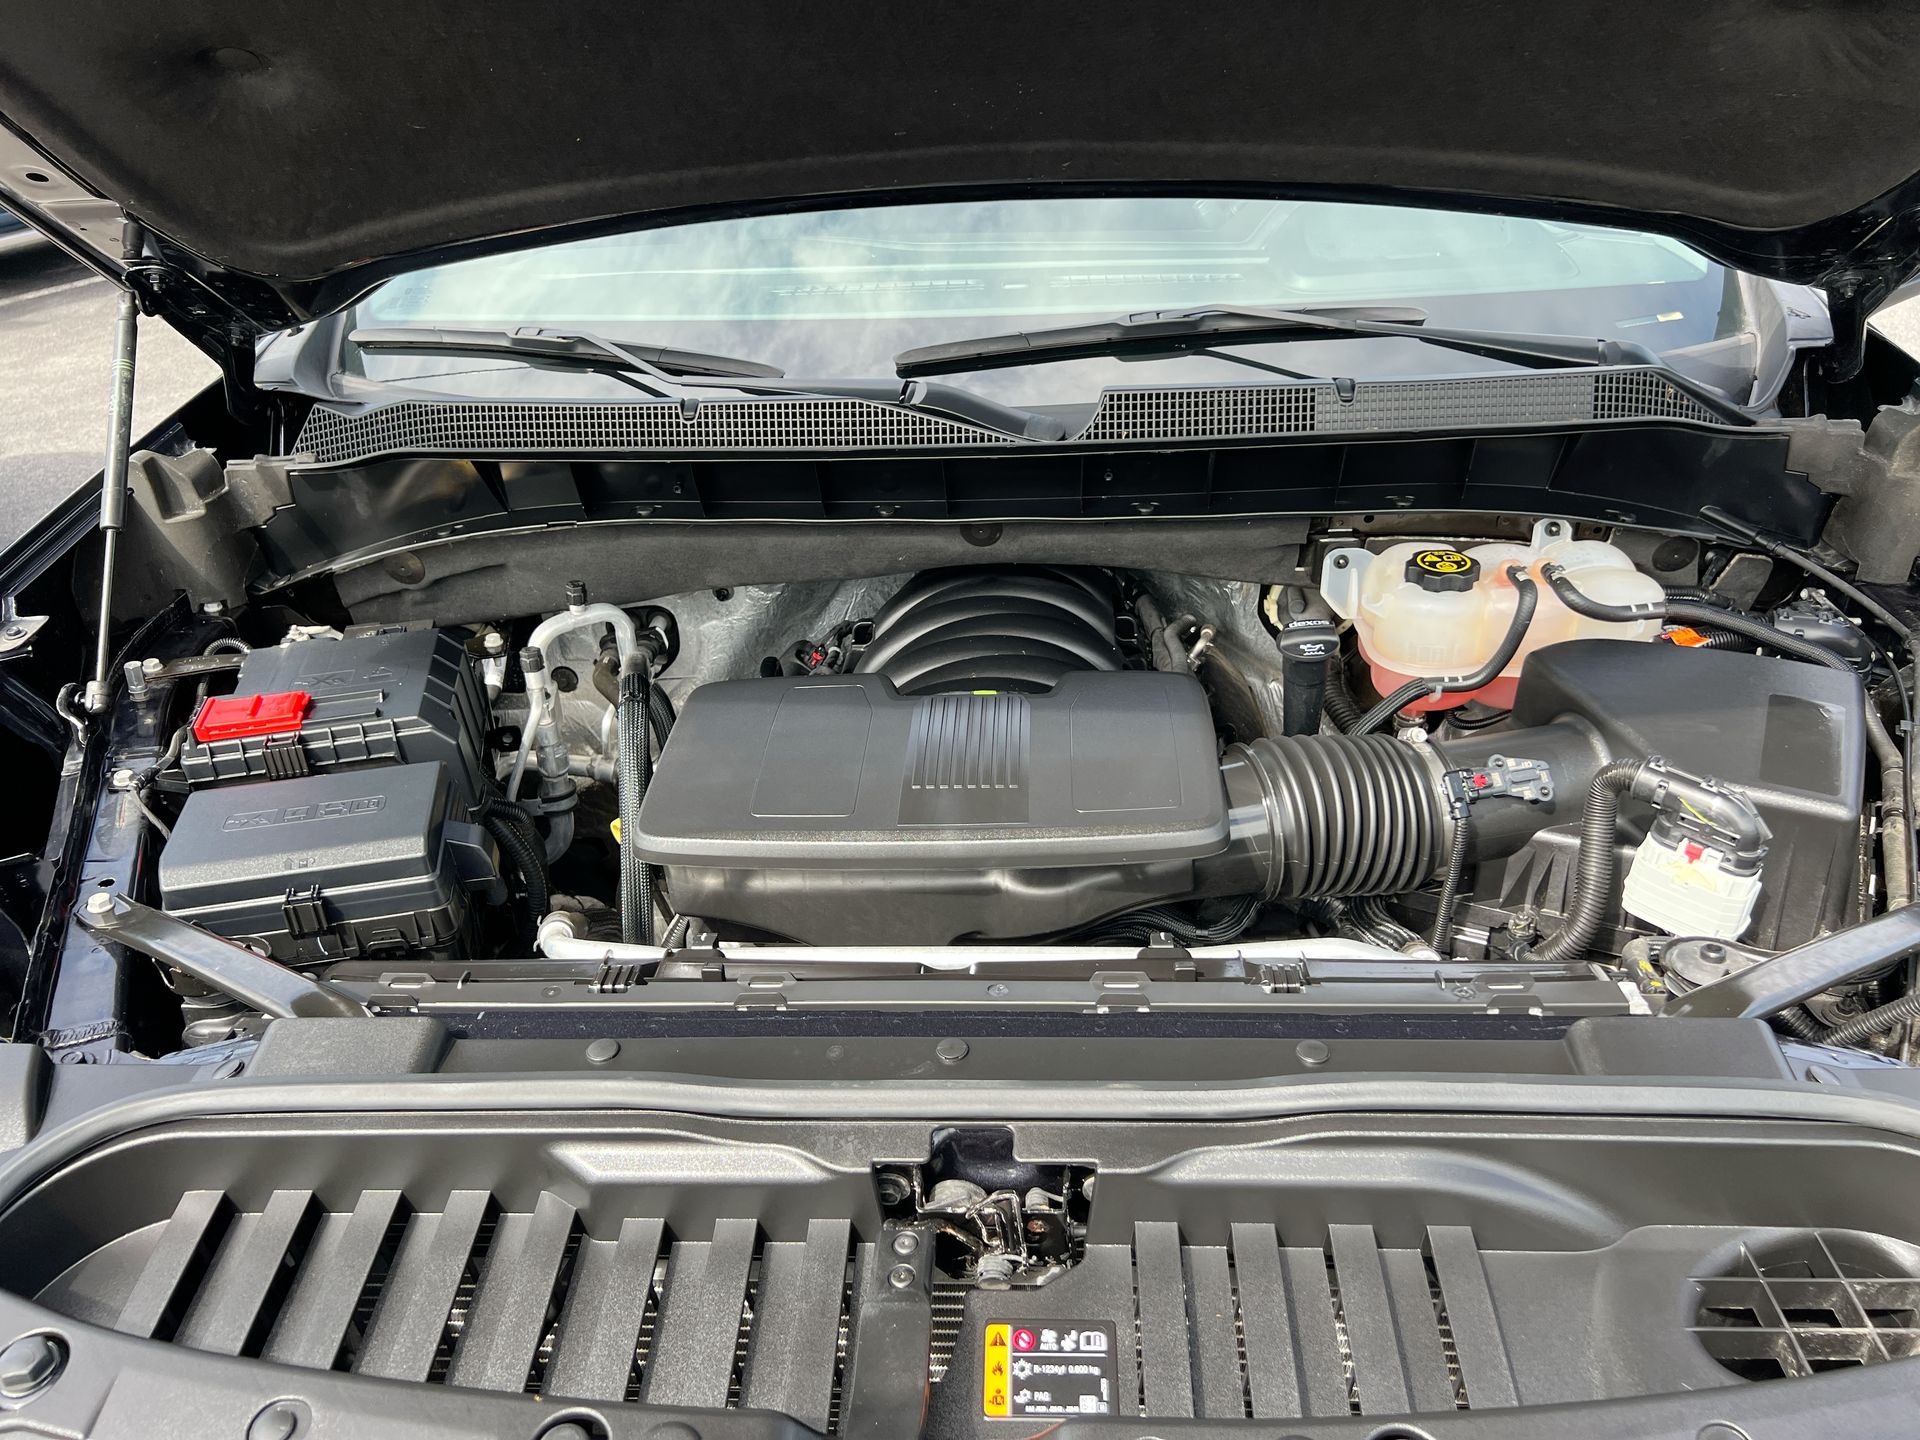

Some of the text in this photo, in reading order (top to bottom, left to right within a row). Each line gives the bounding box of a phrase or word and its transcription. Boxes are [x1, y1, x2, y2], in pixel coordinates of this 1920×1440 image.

[1288, 620, 1330, 628] dexos
[1040, 1342, 1058, 1351] AUTO
[1089, 1364, 1101, 1376] kg
